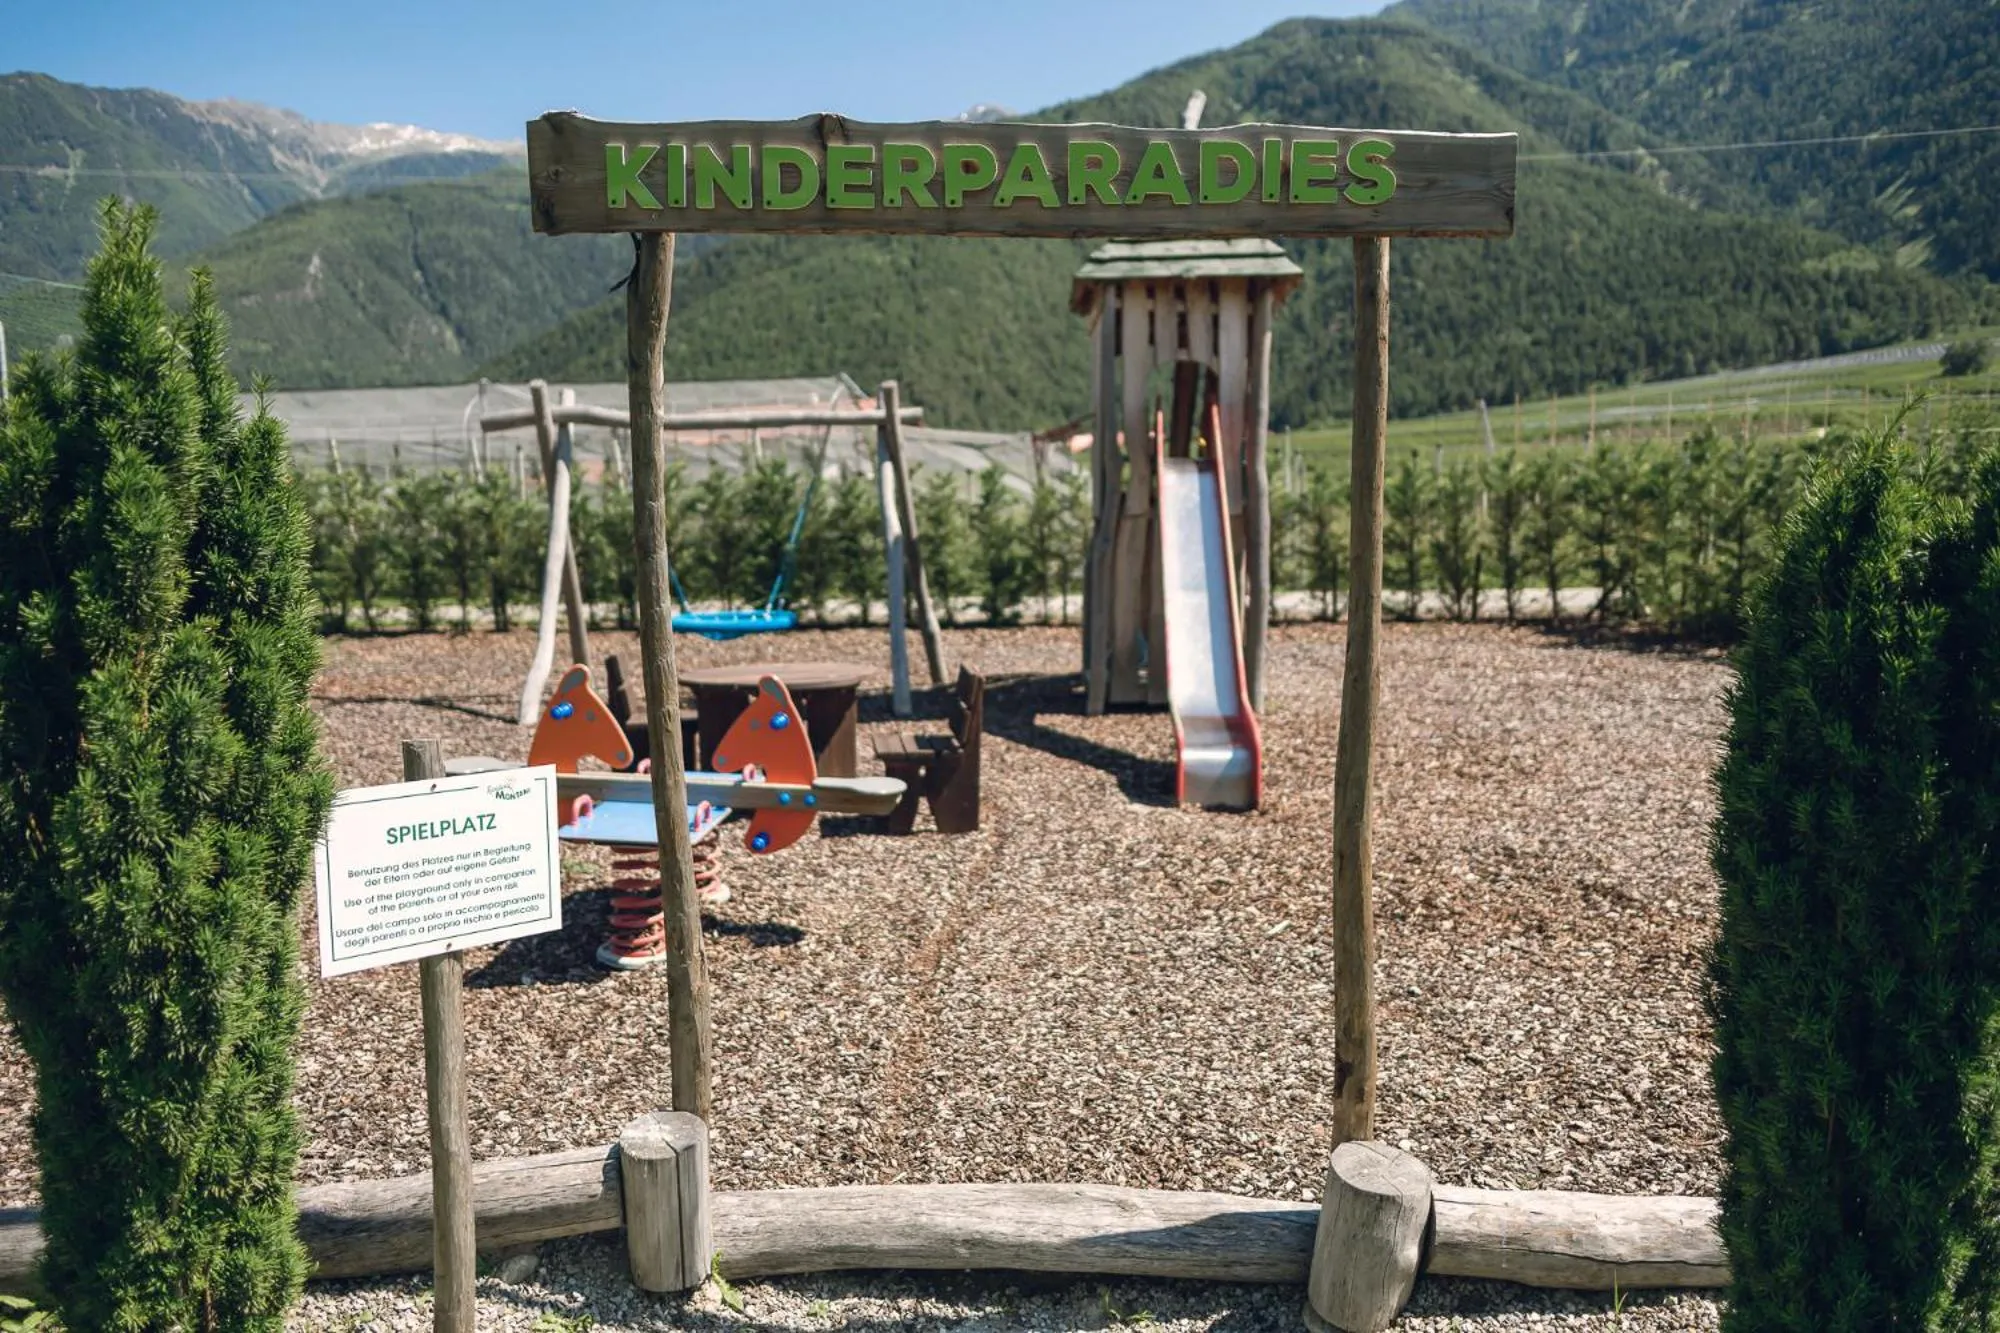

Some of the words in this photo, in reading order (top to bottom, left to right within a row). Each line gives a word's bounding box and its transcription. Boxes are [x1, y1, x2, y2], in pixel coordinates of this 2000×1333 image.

[604, 139, 1399, 211] KINDERPARADIES
[386, 812, 497, 845] SPIELPLATZ
[347, 864, 400, 879] Benutzung
[401, 861, 419, 870] des
[422, 856, 454, 867] Platzes
[483, 843, 531, 857] Begleitung
[364, 878, 381, 888] der
[383, 874, 410, 884] Eltern
[412, 869, 435, 879] oder
[437, 864, 453, 875] auf
[454, 861, 487, 872] eigene
[489, 855, 520, 866] Gefahr
[343, 898, 362, 908] Use
[365, 895, 375, 904] of
[376, 893, 393, 902] the
[395, 882, 451, 900] playground
[452, 879, 472, 889] only
[485, 868, 536, 883] companion
[367, 905, 378, 915] of
[380, 904, 396, 913] the
[398, 896, 435, 911] parents
[460, 888, 481, 899] your
[482, 885, 502, 894] own
[504, 881, 518, 890] risk
[335, 926, 364, 938] Usare
[366, 921, 383, 932] del
[384, 916, 421, 929] campo
[344, 936, 370, 948] degli
[372, 928, 407, 944] parenti
[427, 919, 461, 933] proprio
[463, 912, 493, 925] rischio
[502, 904, 540, 918] pericolo
